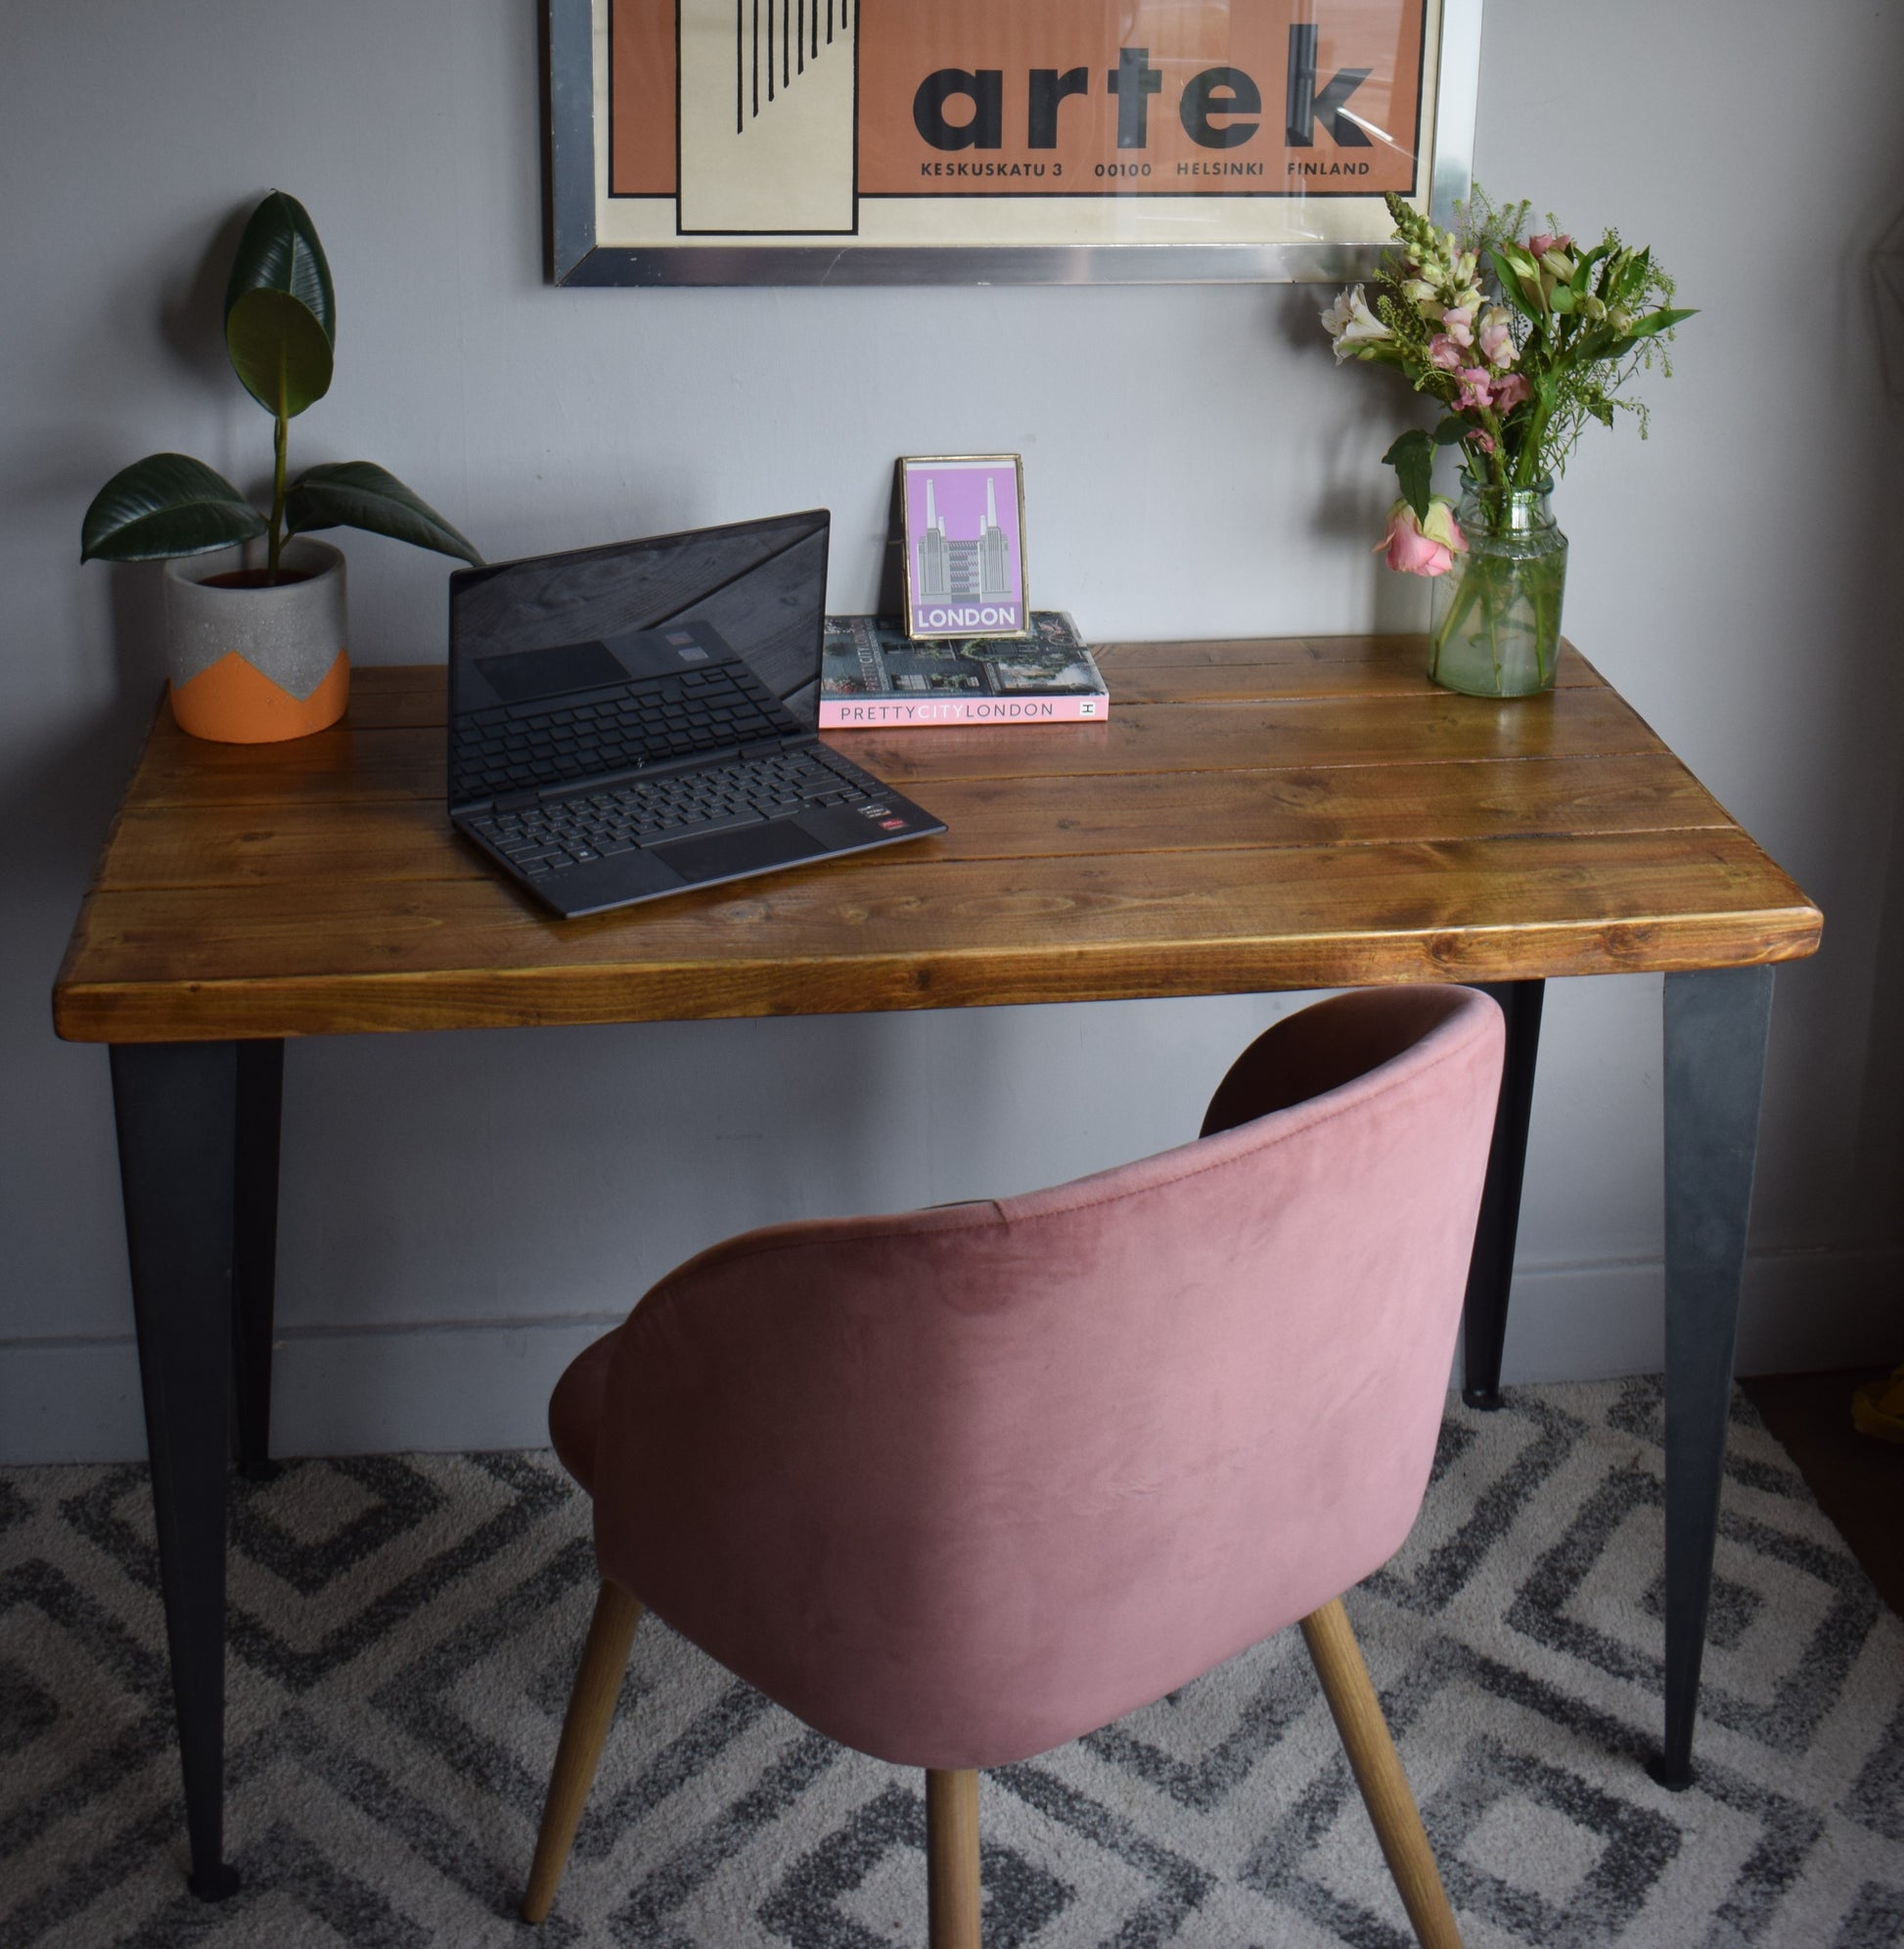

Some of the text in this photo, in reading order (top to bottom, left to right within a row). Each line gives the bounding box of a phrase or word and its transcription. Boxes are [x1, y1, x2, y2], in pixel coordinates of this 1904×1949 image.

[913, 23, 1375, 152] artek
[921, 161, 1370, 177] KESKUSKATU 3 00100 HELSINKI FINLAND
[918, 607, 1015, 628] LONDON
